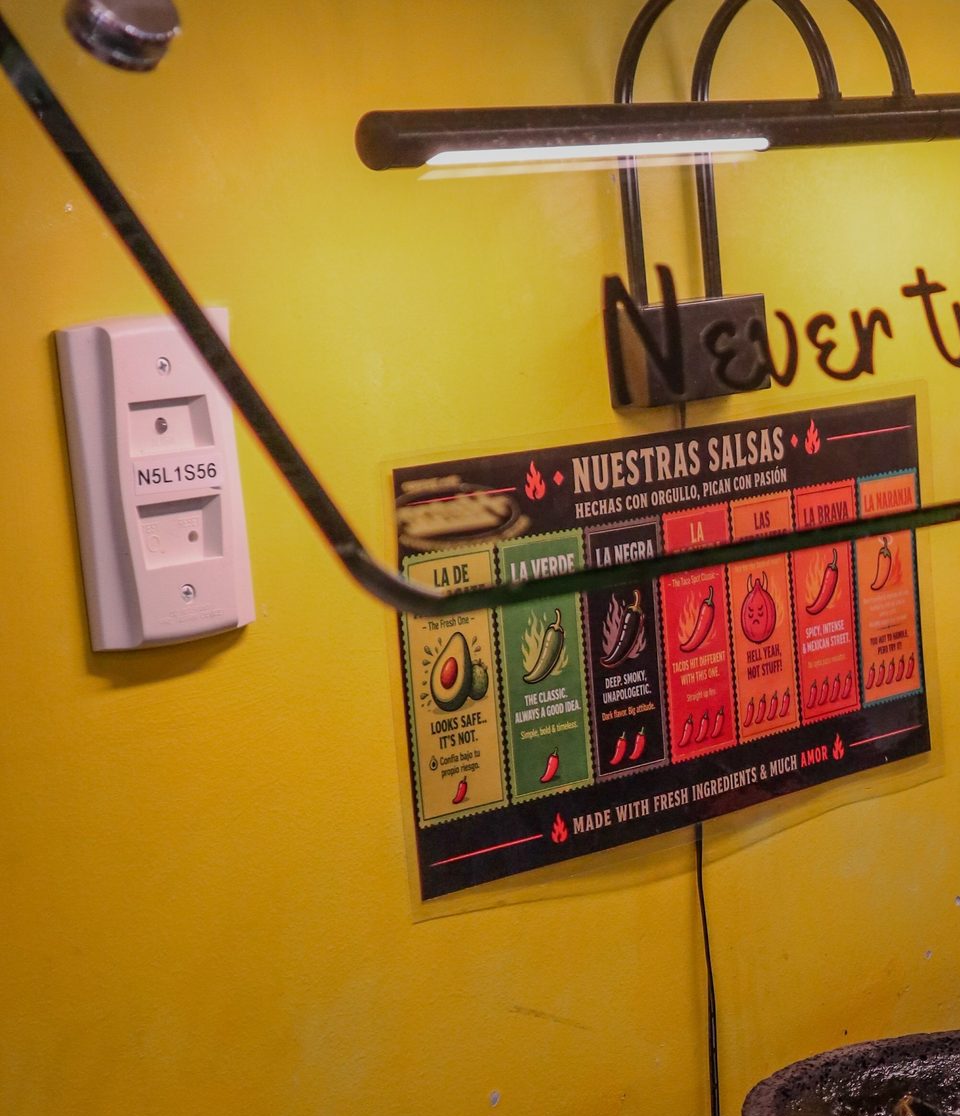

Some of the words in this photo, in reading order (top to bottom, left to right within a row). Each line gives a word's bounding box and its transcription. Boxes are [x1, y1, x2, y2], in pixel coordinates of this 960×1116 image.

[602, 264, 894, 409] Never
[572, 440, 700, 494] NUESTRAS
[708, 426, 784, 472] SALSAS
[137, 462, 217, 486] N5L1S56
[575, 498, 622, 519] HECHAS
[625, 493, 648, 510] CON
[651, 485, 700, 506] ORGULLO,
[703, 479, 731, 498] PICAN
[733, 474, 752, 491] CON
[754, 466, 787, 488] PASIÓN
[864, 495, 874, 512] LA
[875, 487, 912, 509] NARANJA
[754, 511, 770, 530] LAS
[803, 509, 815, 527] LA
[817, 501, 849, 523] BRAVA
[689, 521, 704, 544] LA
[596, 547, 613, 567] LA
[614, 539, 654, 563] NEGRA
[433, 567, 450, 588] LA
[453, 564, 469, 584] DE
[510, 562, 529, 584] LA
[531, 553, 575, 579] VERDE
[428, 620, 439, 631] The
[440, 618, 457, 629] Fresh
[459, 616, 469, 626] One
[672, 660, 689, 674] TACOS
[689, 658, 698, 671] HIT
[699, 651, 725, 667] DIFFERENT
[746, 647, 762, 662] HELL
[624, 670, 648, 686] SMOKY,
[681, 673, 694, 686] WITH
[695, 670, 707, 684] THIS
[747, 666, 760, 680] HOT
[761, 661, 783, 677] STUFF!
[525, 694, 539, 706] THE
[540, 687, 568, 703] CLASSIC.
[603, 683, 652, 704] UNAPOLOGETIC.
[515, 710, 540, 724] ALWAYS
[541, 707, 546, 718] A
[547, 704, 564, 717] GOOD
[565, 699, 581, 714] IDEA.
[601, 711, 613, 721] Dark
[628, 705, 636, 716] Big
[430, 717, 458, 736] LOOKS
[540, 726, 551, 737] bold
[551, 725, 556, 734] &
[439, 733, 456, 750] IT'S
[458, 730, 478, 746] NOT.
[460, 751, 473, 762] bajo
[474, 750, 481, 758] tu
[441, 766, 459, 779] propio
[461, 762, 480, 774] riesgo.
[573, 808, 611, 834] MADE
[616, 799, 649, 823] WITH
[653, 788, 689, 813] FRESH
[692, 767, 757, 801] INGREDIENTS
[760, 764, 767, 780] &
[770, 754, 797, 777] MUCH
[800, 745, 828, 768] AMOR
